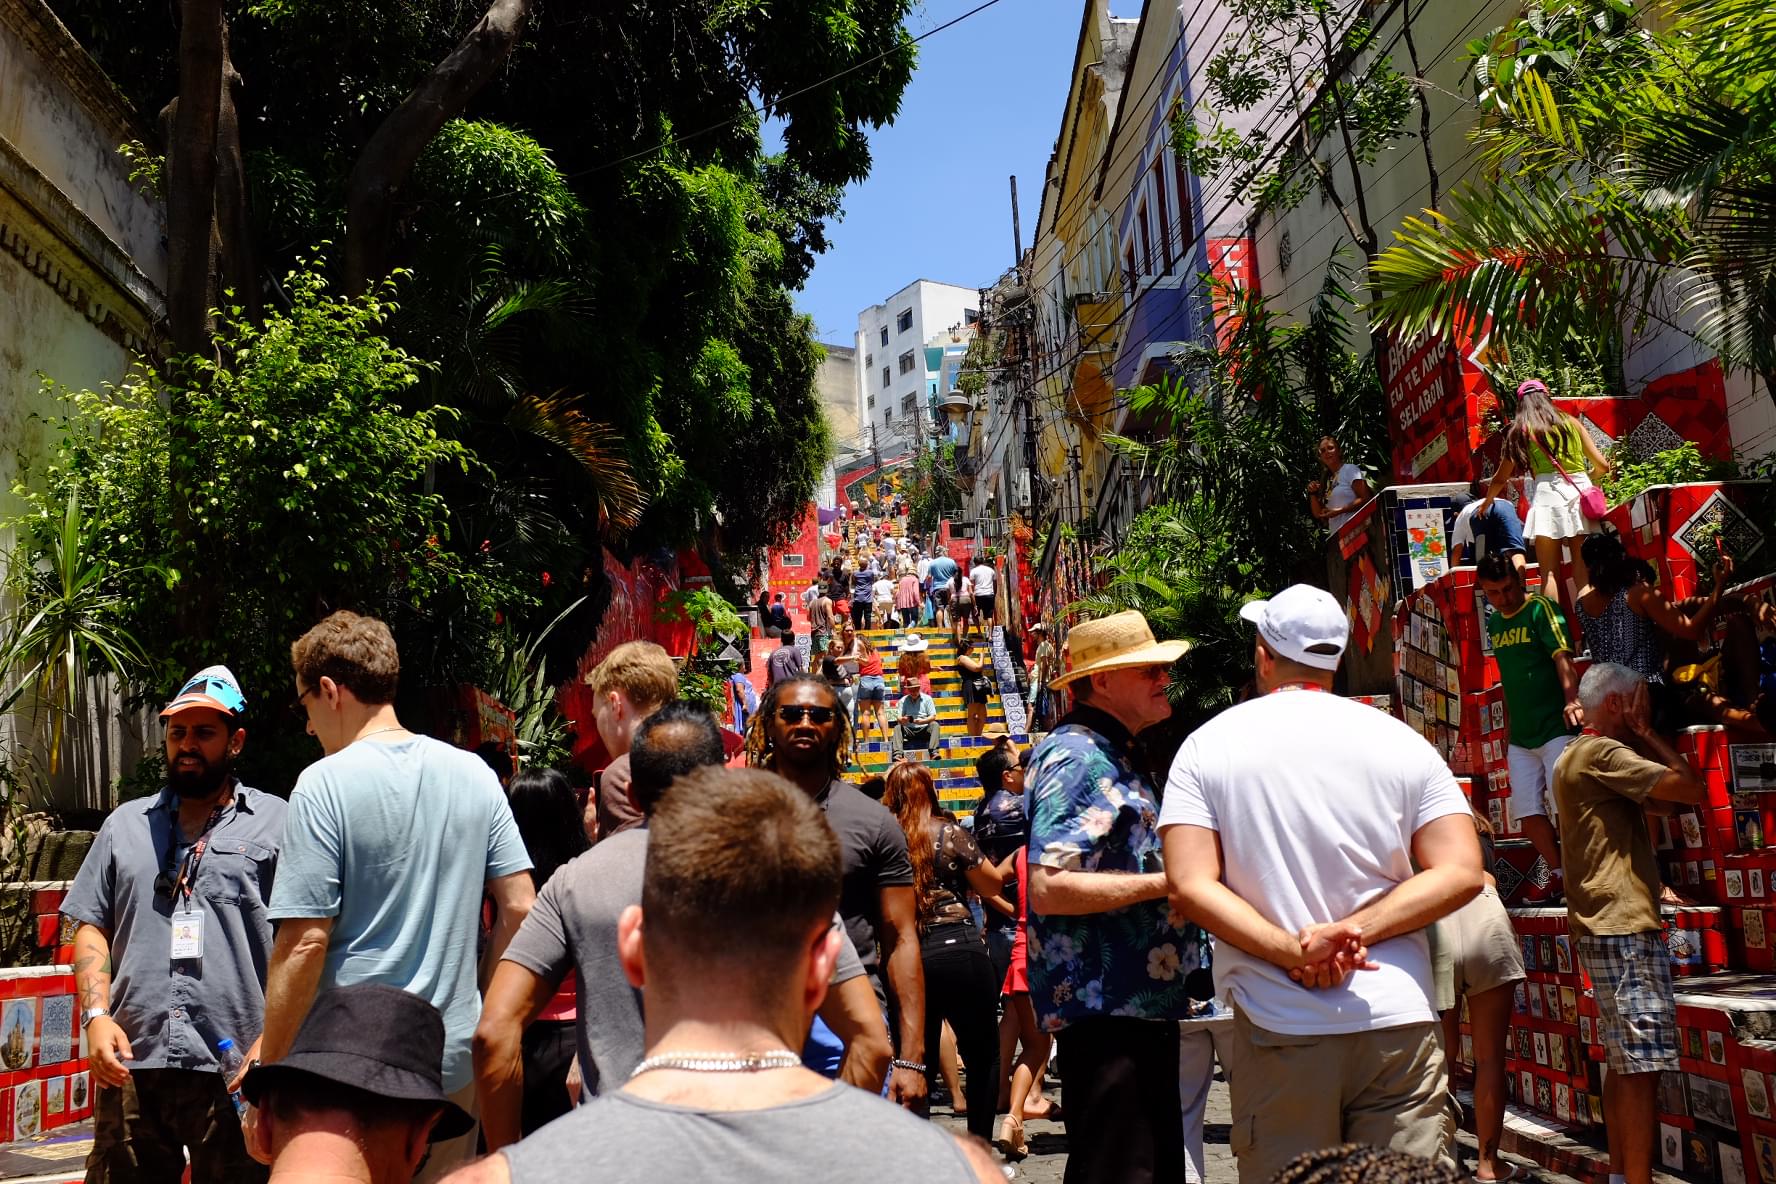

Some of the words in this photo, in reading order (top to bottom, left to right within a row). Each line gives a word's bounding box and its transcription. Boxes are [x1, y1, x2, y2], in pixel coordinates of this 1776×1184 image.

[1391, 383, 1404, 408] EU
[1405, 367, 1421, 390] TE
[1422, 341, 1446, 377] AMO
[1400, 376, 1444, 431] SELARON
[1491, 627, 1531, 648] RASIL
